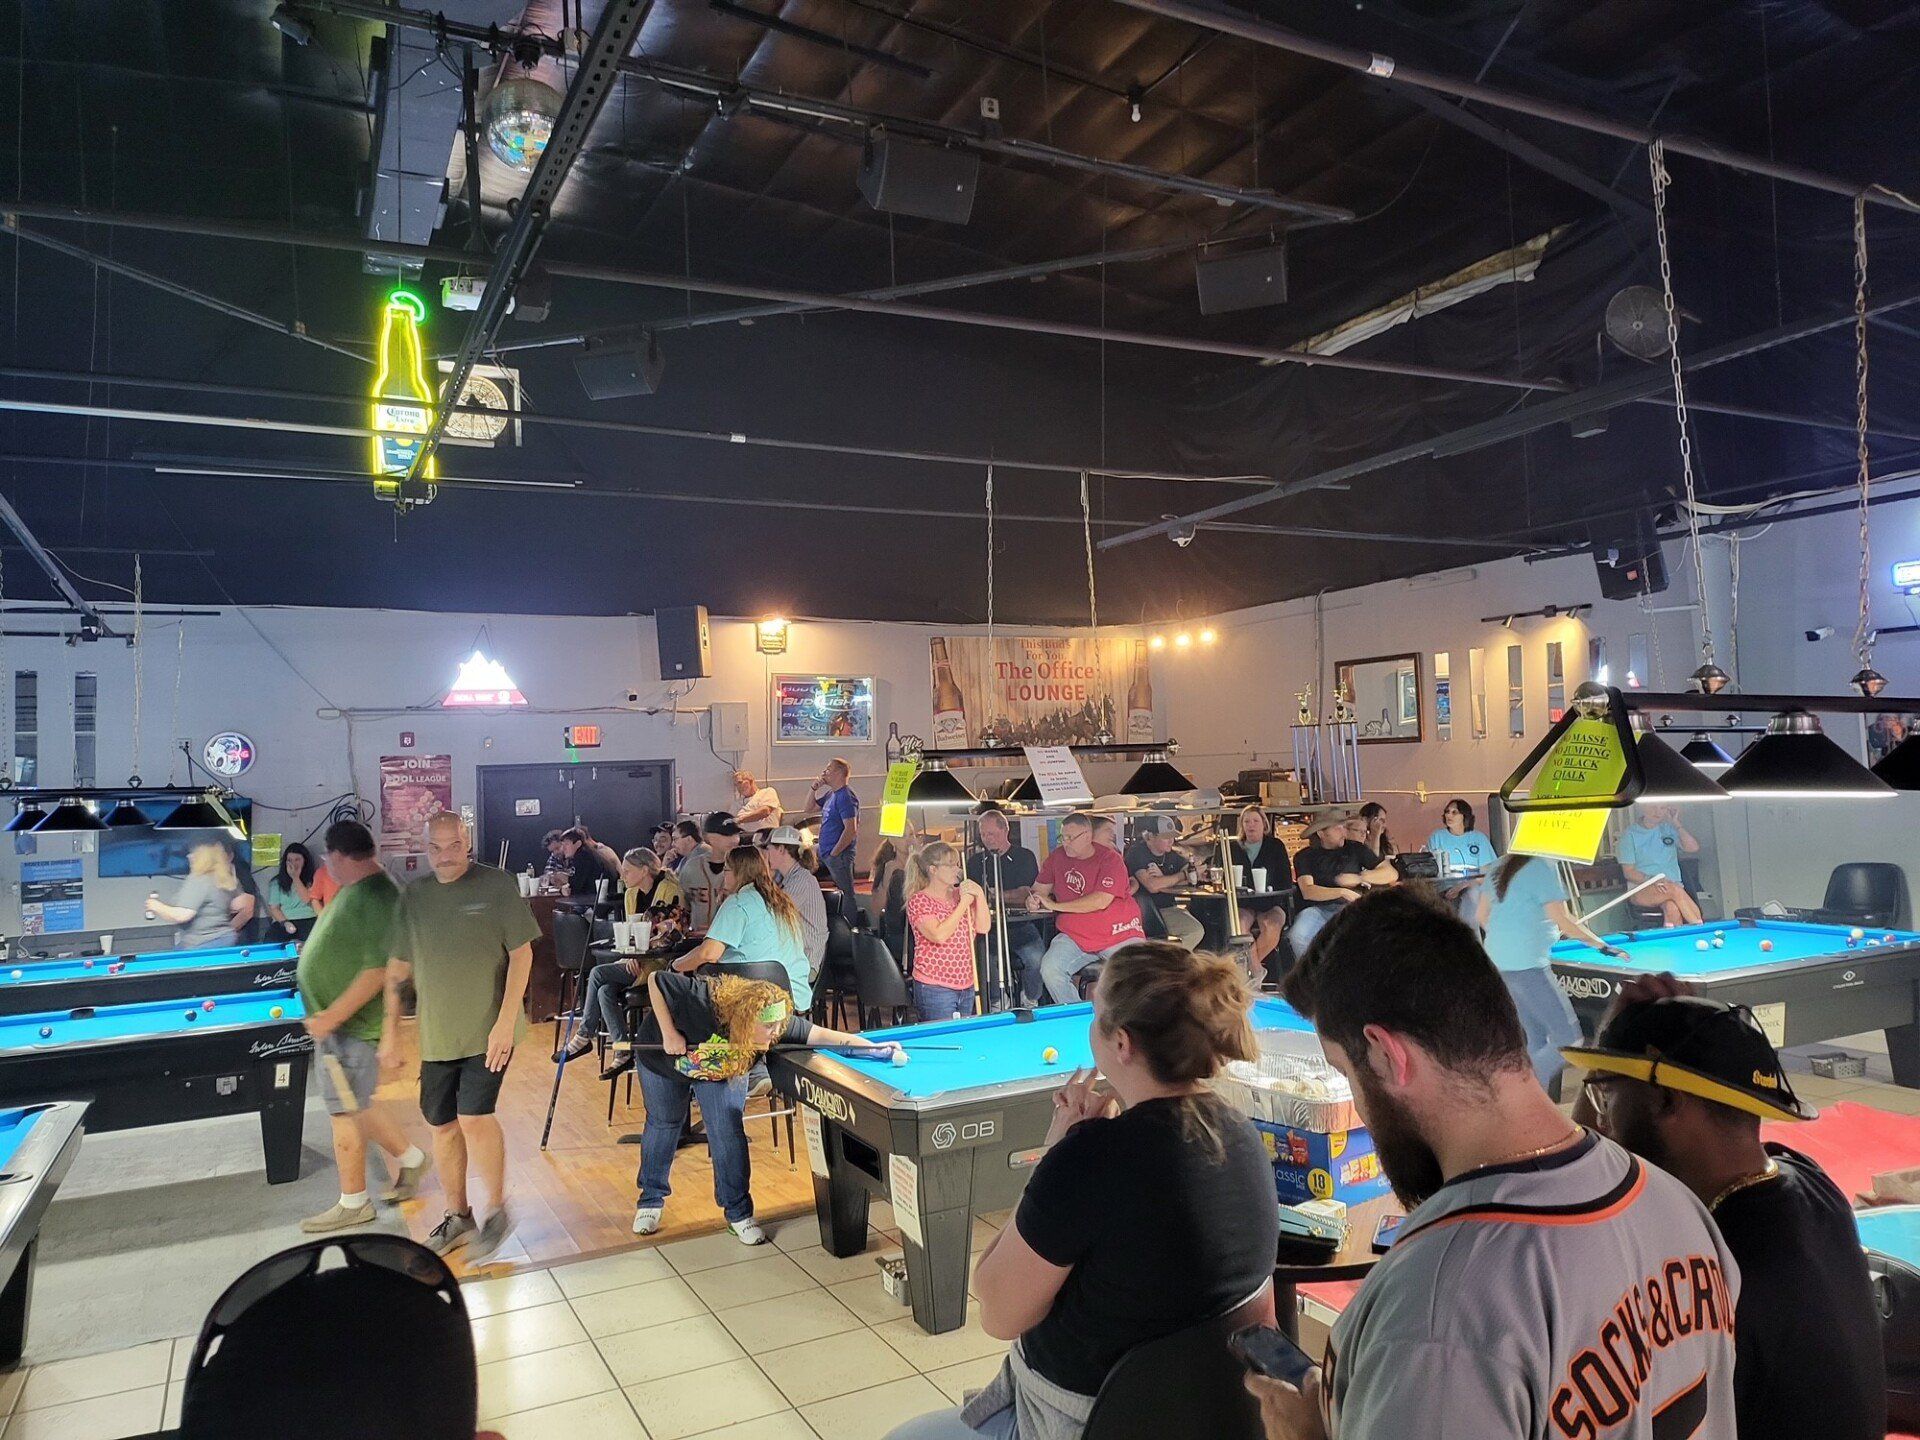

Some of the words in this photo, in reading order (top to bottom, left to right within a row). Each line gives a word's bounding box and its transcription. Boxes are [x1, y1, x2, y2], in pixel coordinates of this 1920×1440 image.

[386, 407, 420, 418] Corona
[1018, 639, 1042, 649] This
[1026, 650, 1042, 660] For
[995, 661, 1033, 679] The
[1037, 660, 1094, 679] Office
[1007, 684, 1085, 701] LOUNGE
[782, 697, 815, 706] BUD
[575, 727, 597, 745] EXIT
[1571, 733, 1609, 745] MASSE
[1563, 746, 1611, 759] JUMPING
[404, 759, 431, 769] JOIN
[1563, 758, 1600, 770] BLACK
[416, 775, 446, 783] LEAGUE
[1552, 769, 1586, 781] CHALK
[278, 1072, 287, 1084] 4
[801, 1076, 848, 1122] DIAMOND
[961, 1120, 995, 1140] OB
[1273, 1165, 1306, 1185] lassic
[1312, 1173, 1326, 1189] 18
